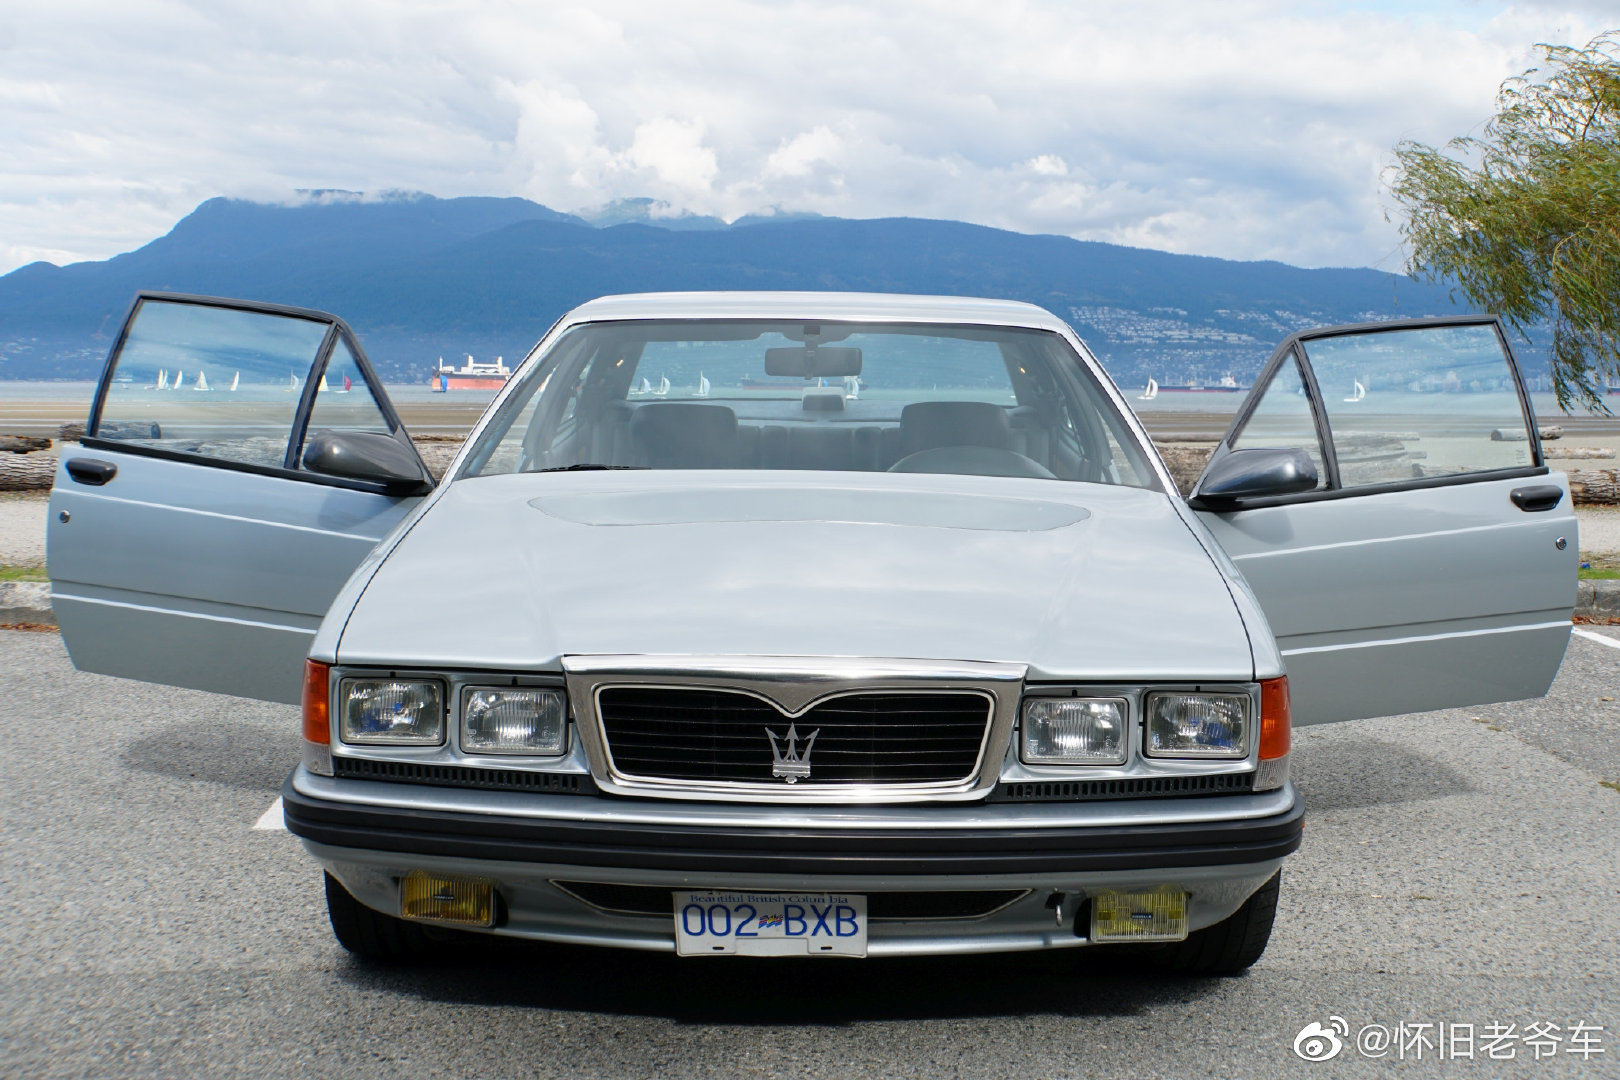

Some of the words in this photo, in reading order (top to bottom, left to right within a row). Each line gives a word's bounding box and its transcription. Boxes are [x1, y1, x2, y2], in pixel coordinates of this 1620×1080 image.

[690, 894, 744, 903] Beautiful
[747, 895, 786, 903] British
[682, 904, 759, 937] 002
[784, 904, 859, 937] BXB
